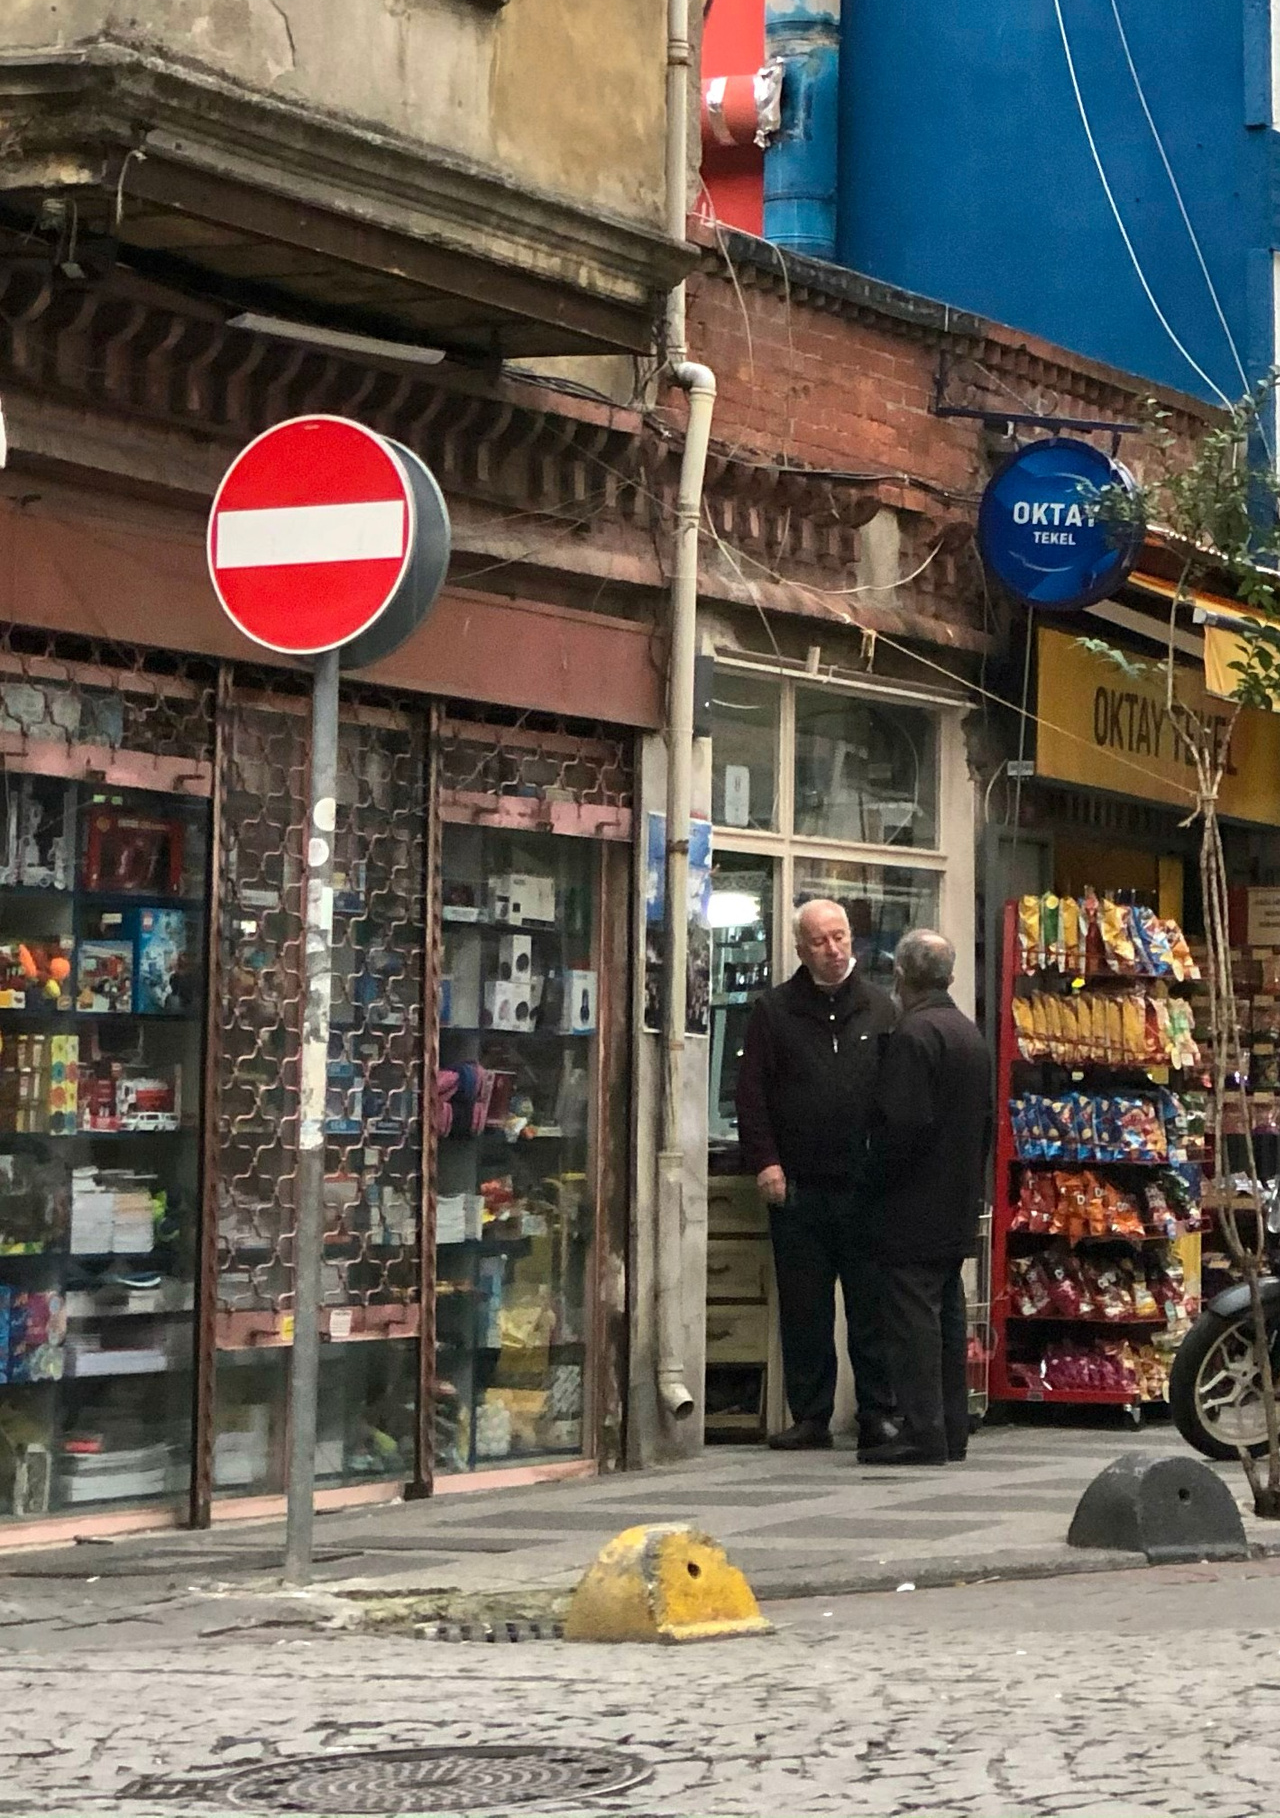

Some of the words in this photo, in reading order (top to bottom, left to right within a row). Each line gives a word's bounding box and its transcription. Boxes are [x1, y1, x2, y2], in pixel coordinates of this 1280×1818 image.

[1013, 501, 1101, 527] OKTAY
[1033, 531, 1076, 545] TEKEL
[1094, 686, 1164, 758] OKTAY
